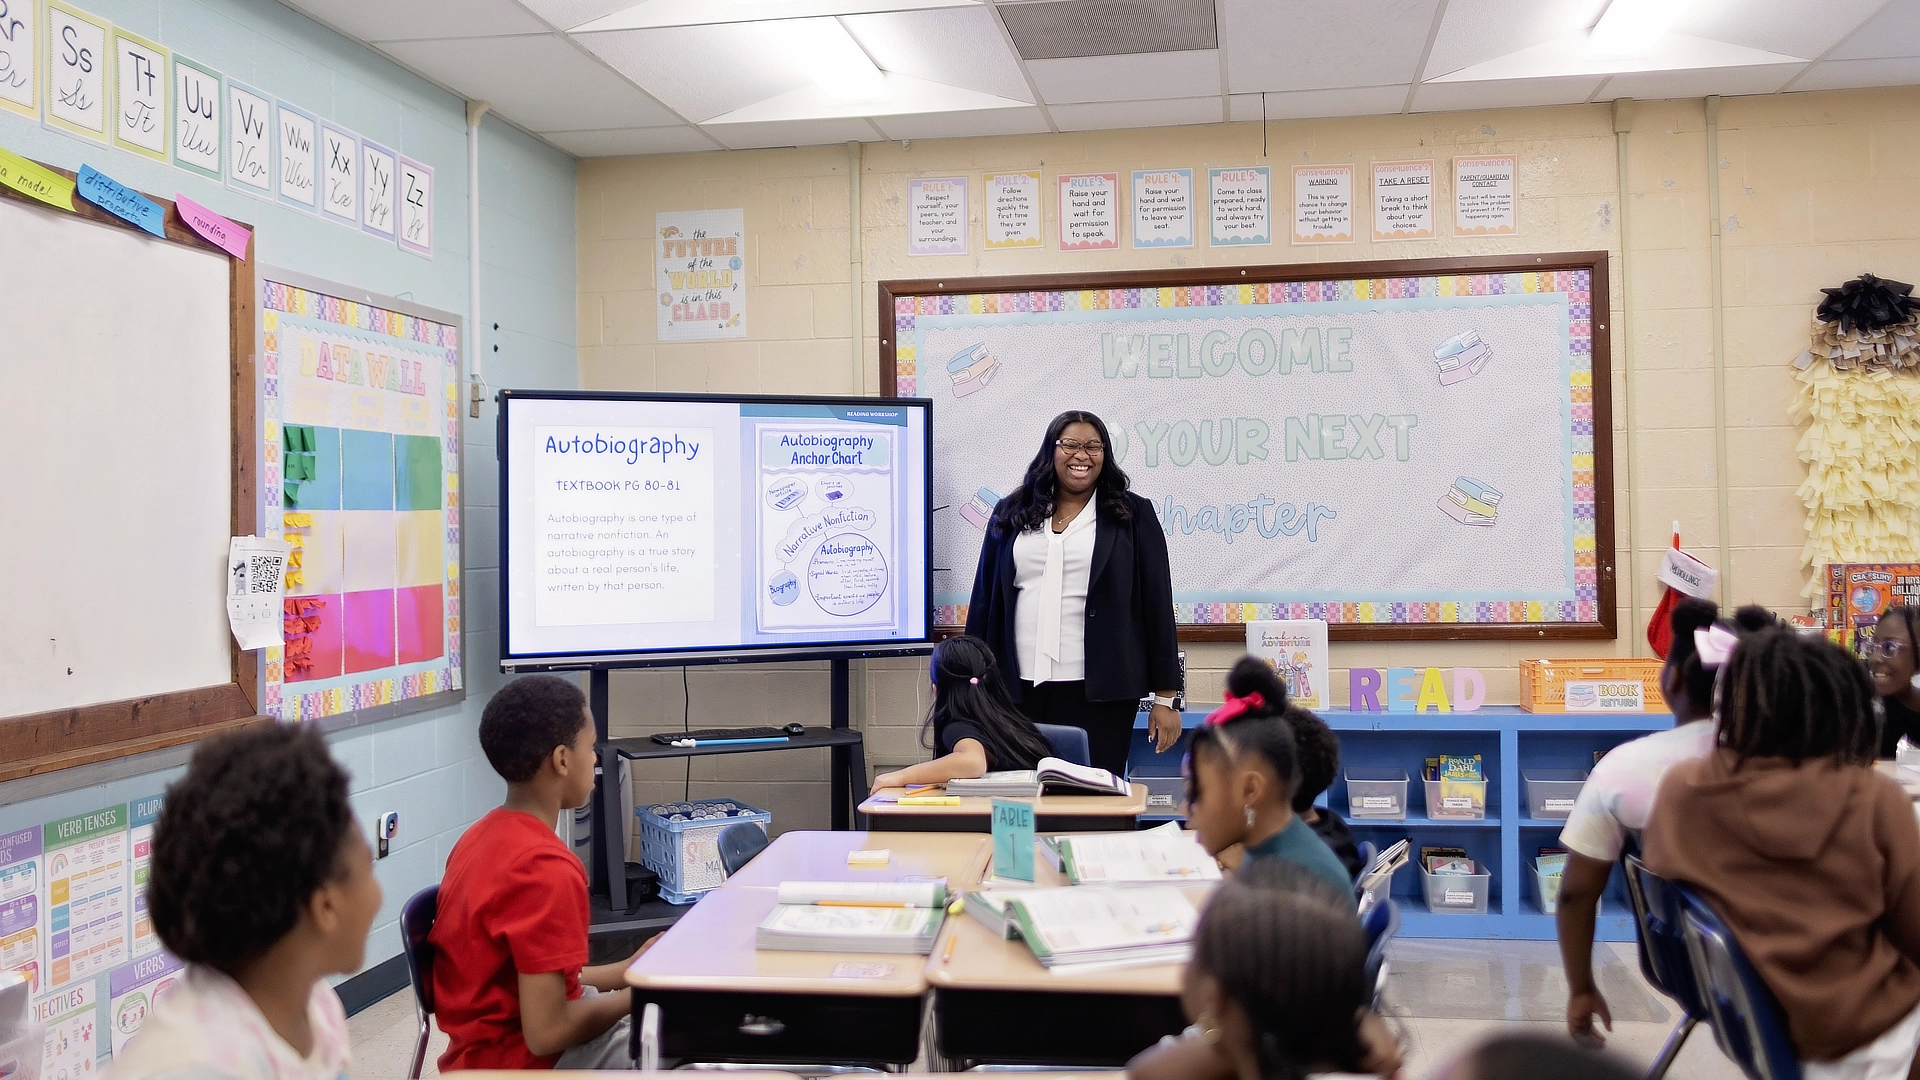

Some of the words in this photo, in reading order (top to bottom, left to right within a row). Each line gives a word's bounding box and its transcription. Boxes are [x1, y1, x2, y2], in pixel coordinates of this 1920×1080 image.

[62, 25, 92, 73] Ss
[128, 51, 155, 96] Tt
[184, 75, 213, 120] Uu
[125, 100, 155, 132] Tt
[238, 98, 264, 140] Vv
[284, 122, 310, 153] Ww
[330, 138, 351, 176] Xx
[370, 153, 389, 196] Yy
[995, 176, 1018, 186] RULE
[1022, 175, 1029, 184] 2:
[1071, 178, 1094, 188] RULE
[1098, 177, 1105, 187] 3:
[1144, 174, 1168, 184] RULE
[1171, 174, 1180, 183] 4:
[1222, 172, 1246, 182] RULE
[1249, 171, 1257, 181] 5:
[1407, 176, 1429, 184] RESET
[17, 173, 54, 198] model
[85, 172, 150, 217] distributive
[406, 172, 424, 207] Zz
[923, 183, 945, 192] RULE
[97, 195, 140, 225] property
[1072, 199, 1089, 207] hand
[1092, 198, 1105, 206] and
[1152, 205, 1186, 213] permission
[193, 215, 226, 246] rounding
[1070, 220, 1108, 229] permission
[1083, 229, 1105, 238] speak.
[693, 229, 706, 240] the
[663, 237, 737, 258] FUTURE
[687, 258, 696, 272] of
[699, 258, 712, 269] the
[668, 269, 733, 290] WORLD
[680, 294, 688, 304] is
[690, 291, 702, 302] in
[705, 289, 721, 301] this
[672, 302, 730, 321] CLASS
[1101, 327, 1353, 379] WELCOME
[299, 337, 364, 386] DATA
[366, 353, 425, 396] WALL
[546, 433, 699, 465] Autobiography
[780, 433, 874, 451] Autobiography
[1134, 417, 1270, 467] YOUR
[1285, 413, 1418, 462] NEXT
[791, 451, 830, 465] Anchor
[832, 450, 862, 465] Chart
[556, 480, 621, 491] TEXTBOOK
[625, 480, 640, 491] PG
[644, 480, 680, 490] 80-81
[547, 513, 625, 525] Autobiography
[628, 513, 636, 522] is
[662, 513, 683, 524] type
[686, 512, 696, 522] of
[547, 531, 594, 540] narrative
[597, 529, 652, 539] nonfiction.
[655, 530, 669, 538] An
[783, 522, 823, 557] Narrative
[823, 510, 869, 527] Nonfiction
[547, 547, 624, 559] autobiography
[628, 547, 635, 556] is
[649, 547, 668, 556] true
[671, 547, 695, 557] story
[821, 540, 873, 557] Autobiography
[547, 565, 579, 575] about
[592, 564, 612, 573] real
[616, 563, 658, 576] person's
[661, 562, 679, 573] life,
[547, 582, 584, 592] written
[588, 581, 600, 593] by
[604, 581, 624, 590] that
[628, 582, 665, 592] person.
[769, 578, 797, 595] Biography
[1262, 631, 1290, 640] book
[1859, 625, 1876, 638] UN
[1349, 667, 1486, 712] READ
[1598, 684, 1638, 696] BOOK
[1600, 698, 1638, 707] RETURN
[137, 798, 163, 817] PLURA
[992, 805, 1029, 827] TABLE
[58, 819, 81, 839] VERB
[84, 810, 116, 832] TENSES
[88, 840, 105, 850] PRESENT
[686, 841, 716, 862] STU
[1010, 833, 1015, 869] 1
[706, 861, 720, 870] MA
[134, 954, 165, 980] VERBS
